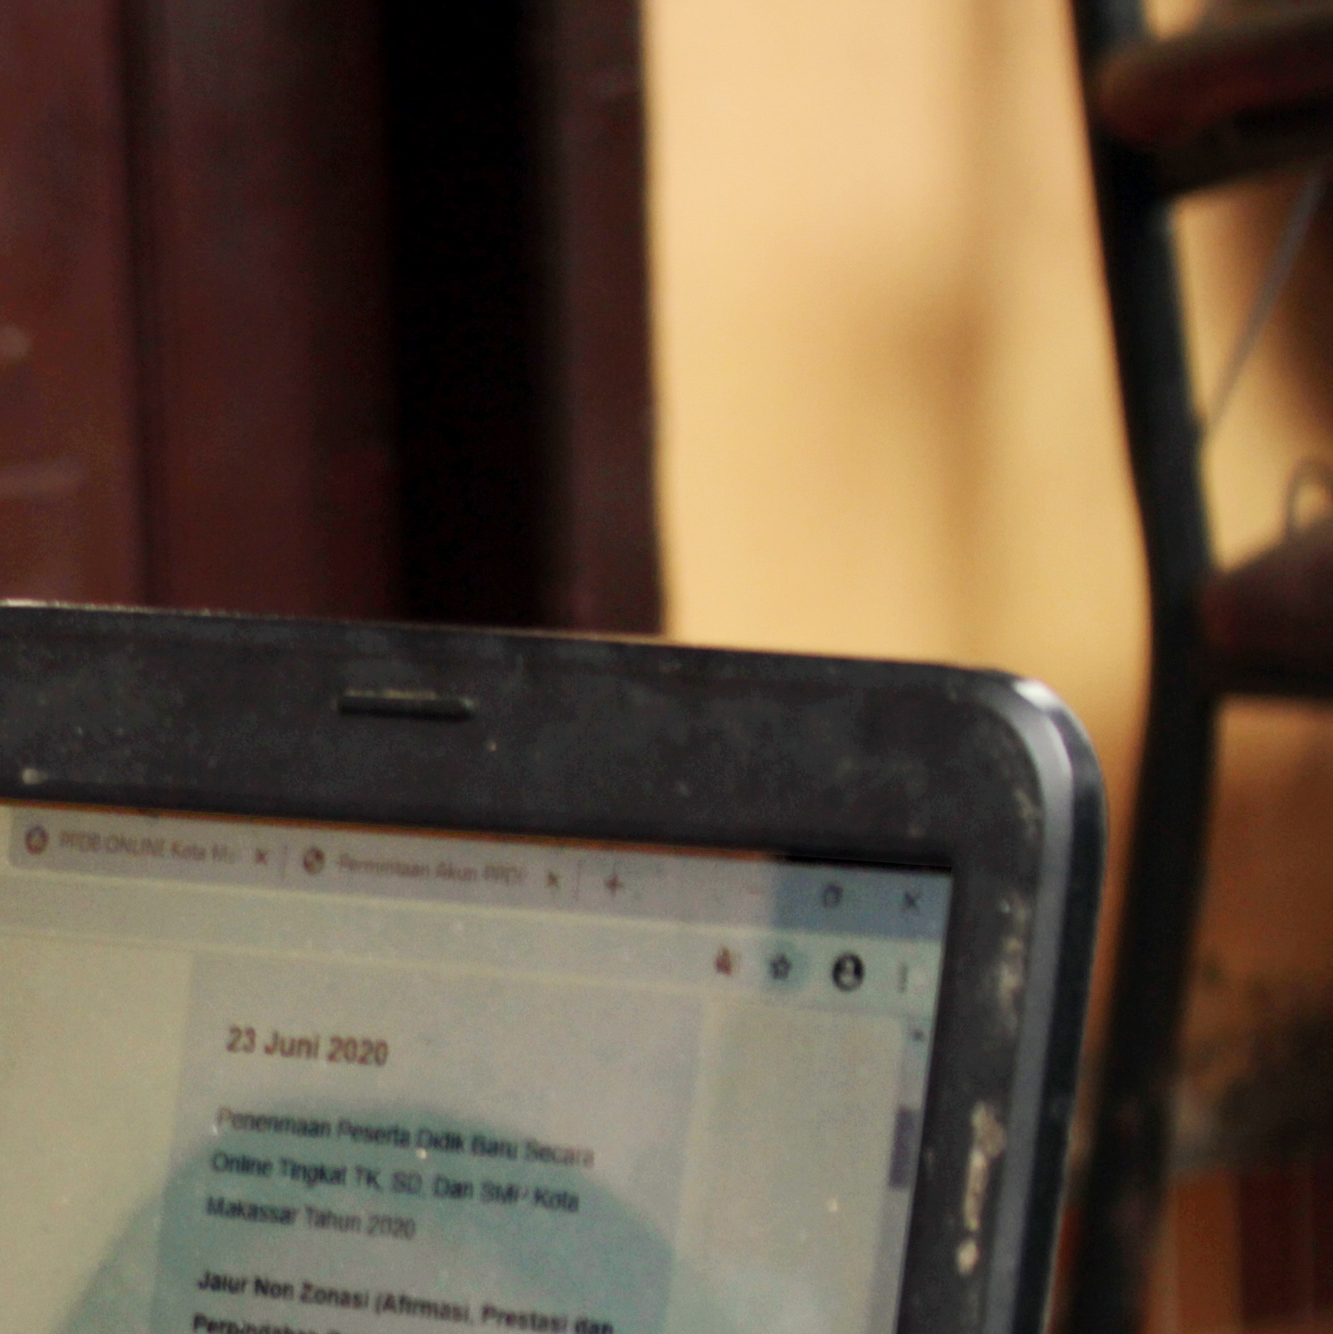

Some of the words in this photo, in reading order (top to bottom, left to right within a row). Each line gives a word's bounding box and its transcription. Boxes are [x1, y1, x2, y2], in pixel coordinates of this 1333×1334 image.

[226, 1025, 256, 1054] 23
[263, 1030, 321, 1061] Juni
[327, 1036, 390, 1067] 2020
[336, 1118, 412, 1147] Peserta
[416, 1127, 466, 1154] Didik
[471, 1135, 518, 1162] Baru
[210, 1149, 274, 1178] Online
[279, 1157, 347, 1190] Tingkat
[533, 1187, 580, 1214] Kota
[205, 1196, 302, 1226] Makassar
[304, 1206, 363, 1233] Tahun
[366, 1213, 417, 1240] 2020
[196, 1270, 249, 1295] Jalur
[253, 1274, 295, 1300] Non
[298, 1280, 370, 1309] Zonasi
[480, 1304, 568, 1334] Prestasi
